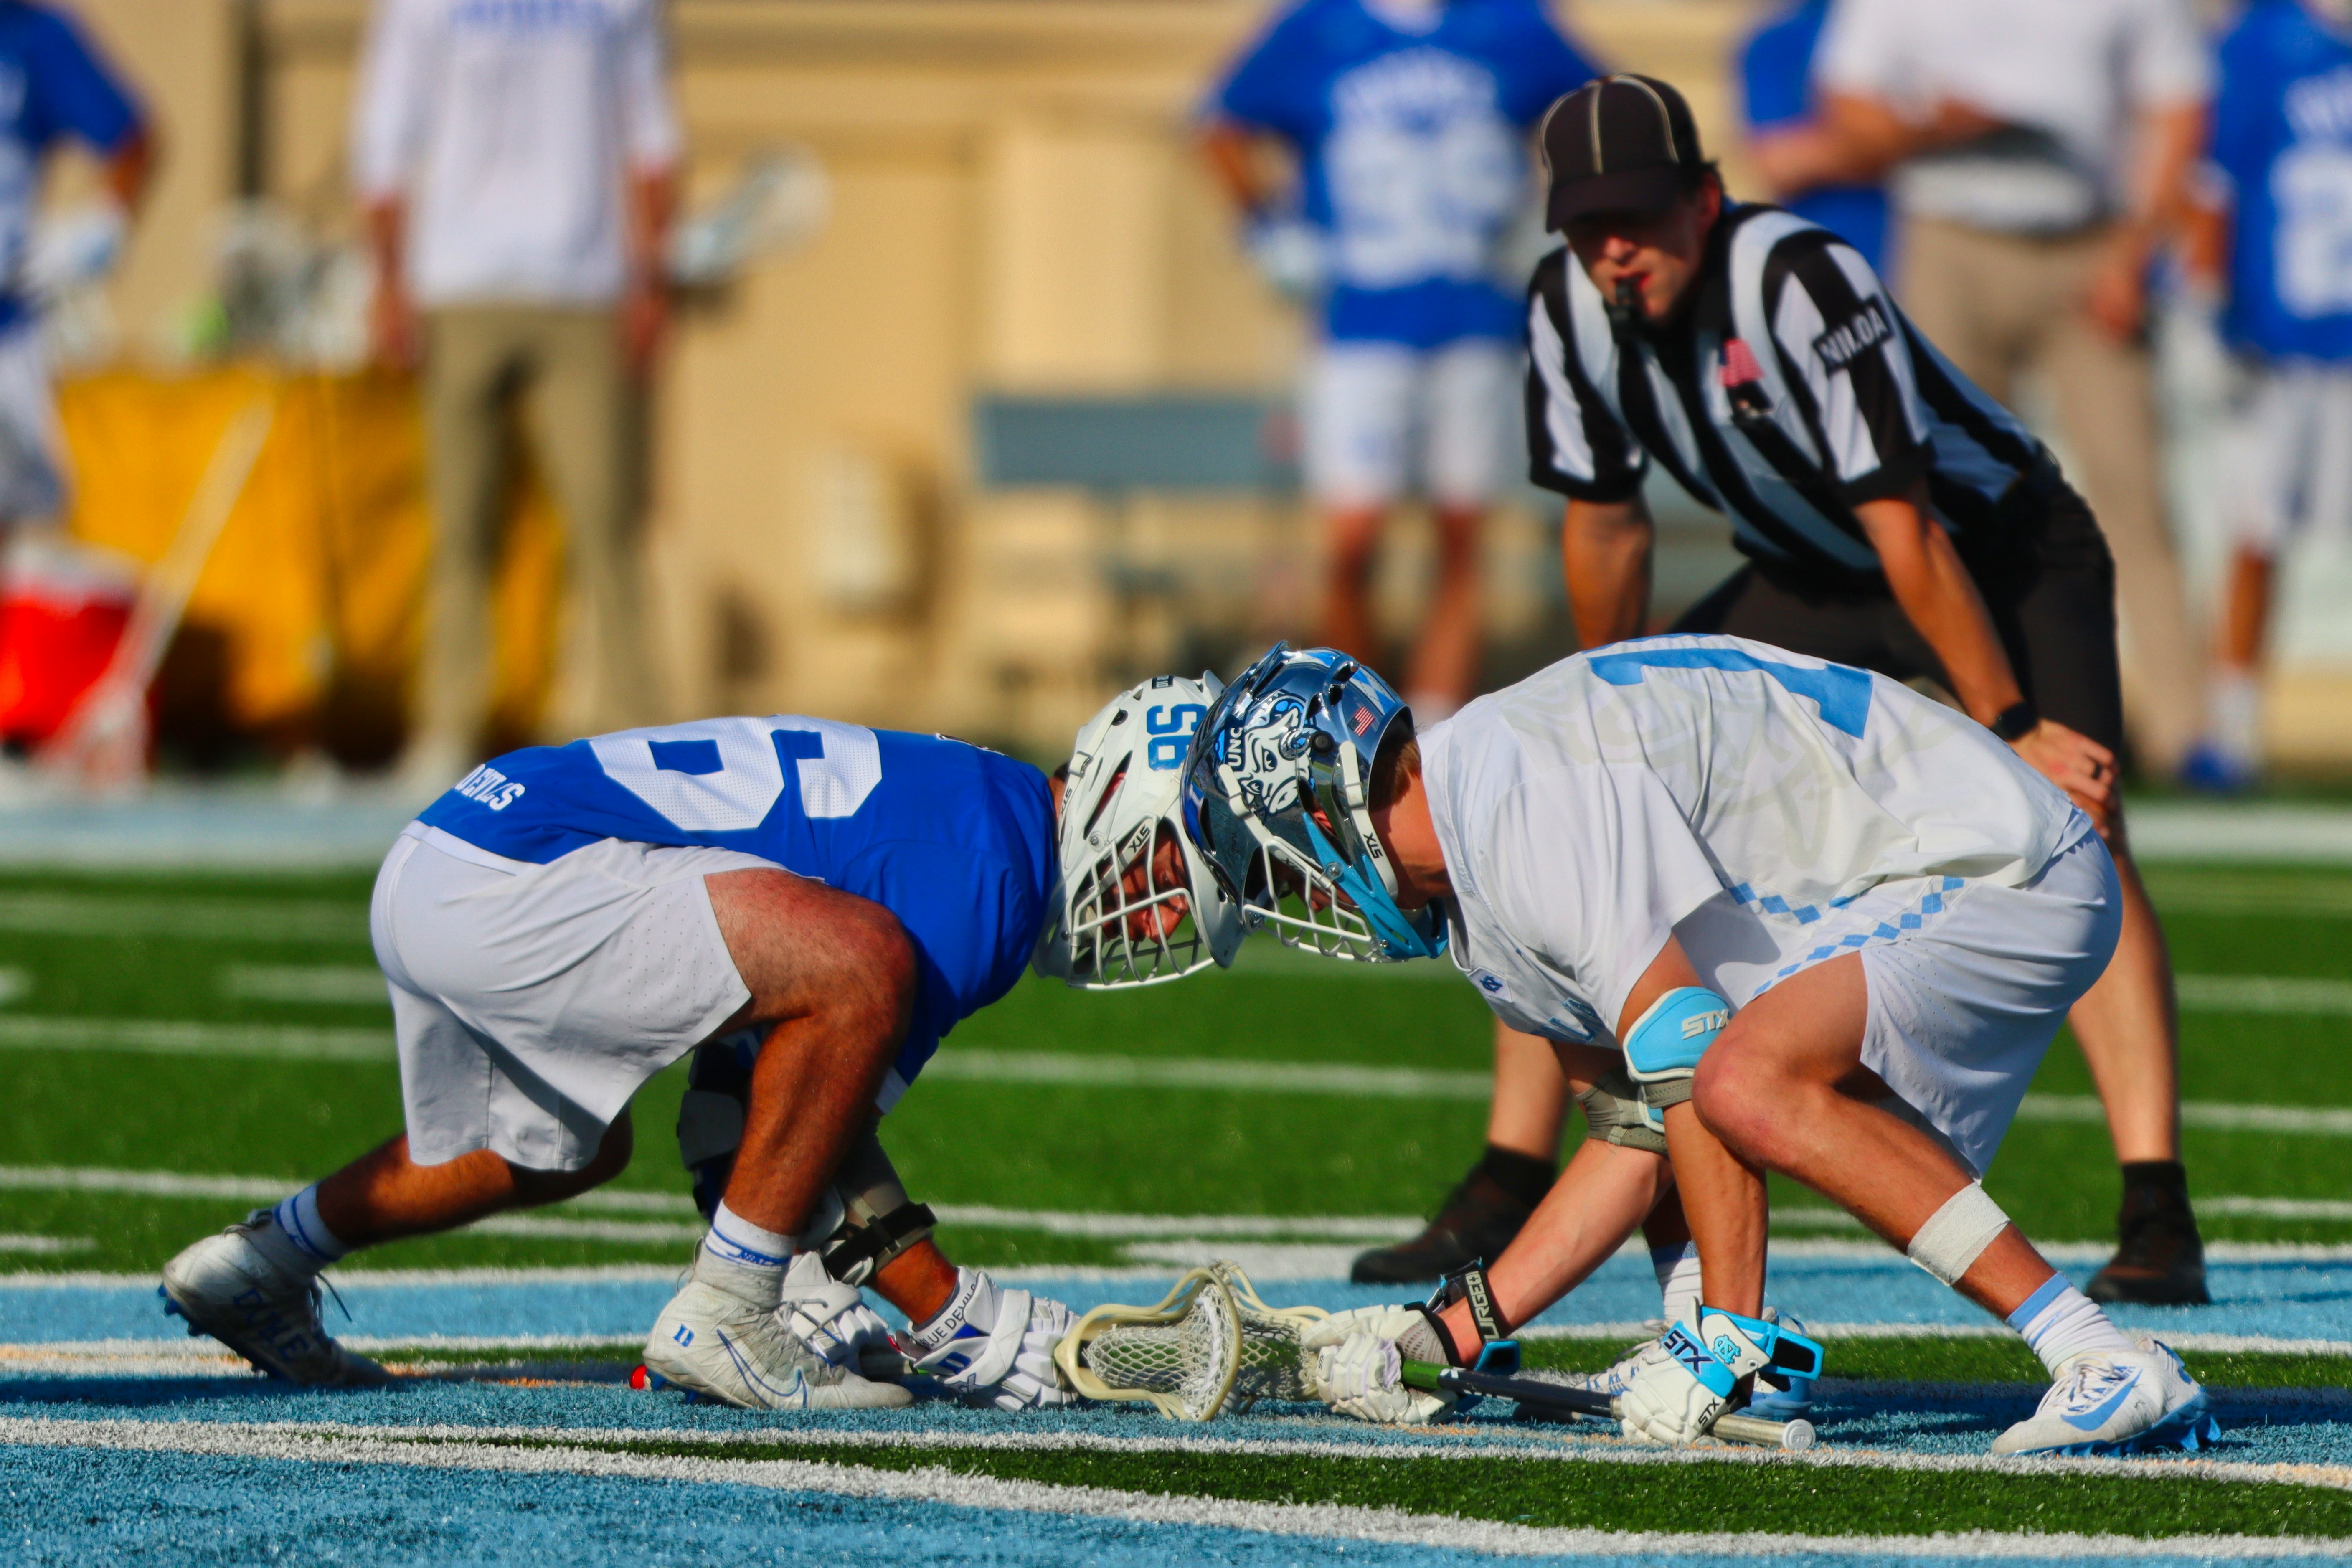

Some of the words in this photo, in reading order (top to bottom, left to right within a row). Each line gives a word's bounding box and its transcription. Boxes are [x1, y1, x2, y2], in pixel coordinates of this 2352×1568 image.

[1147, 703, 1207, 771] 56
[1228, 727, 1243, 766] UNC
[1060, 787, 1073, 816] STX
[1129, 824, 1151, 853] STX
[1362, 832, 1383, 859] STX
[1682, 1009, 1730, 1040] STX
[919, 1326, 948, 1348] BLUE
[1663, 1329, 1715, 1375] STX
[1698, 1398, 1721, 1426] STX
